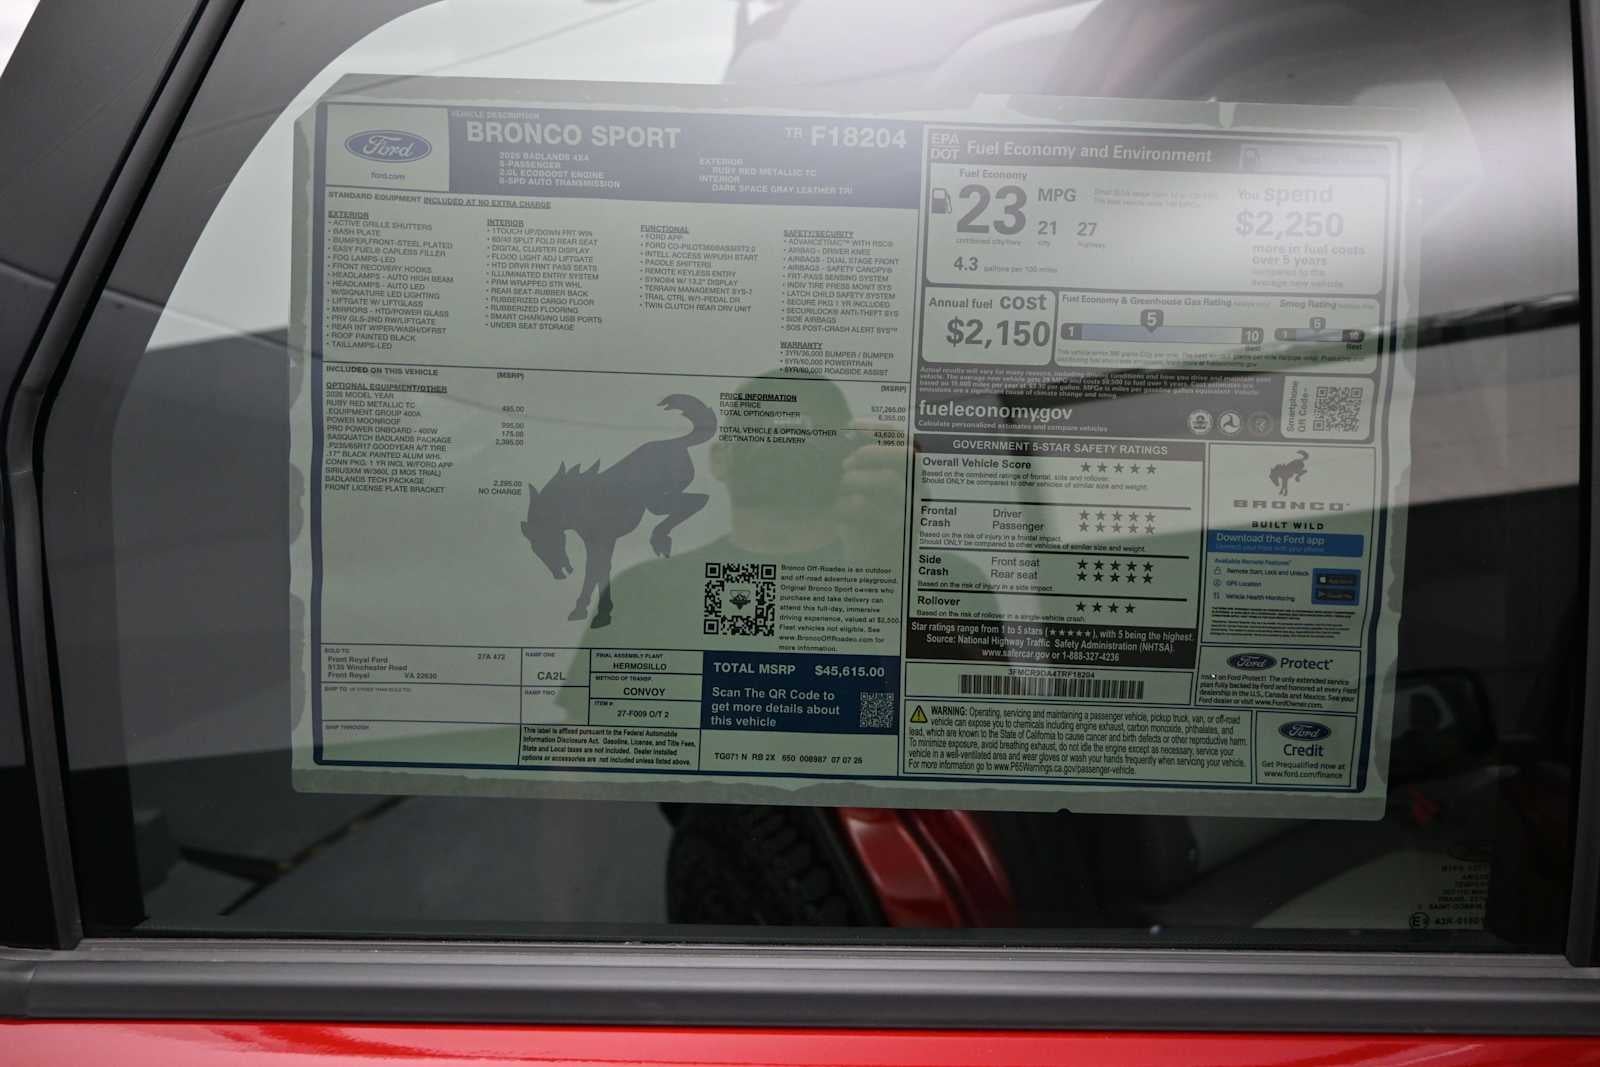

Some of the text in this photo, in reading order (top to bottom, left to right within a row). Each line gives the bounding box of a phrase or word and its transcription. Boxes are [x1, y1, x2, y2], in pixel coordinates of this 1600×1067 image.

[467, 121, 682, 149] BRONCO SPORT
[785, 125, 907, 149] TR F18204
[931, 134, 959, 144] EPA
[930, 148, 960, 160] DOT
[967, 141, 1212, 162] Fuel Economy and Environment
[370, 172, 406, 180] ford.com
[760, 168, 802, 176] METALLIC
[960, 168, 1028, 181] Fuel Economy
[554, 180, 621, 188] TRANSMISSION
[699, 175, 740, 184] INTERIOR
[712, 184, 768, 193] DARK SPACE
[328, 192, 551, 208] STANDARD EQUIPMENT EXTRA CHARGE
[1238, 188, 1333, 206] You spend
[328, 211, 369, 219] EXTERIOR
[956, 184, 1027, 235] 23
[1038, 188, 1077, 202] MPG
[392, 222, 432, 231] SHUTTERS
[488, 220, 524, 228] INTERIOR
[641, 225, 689, 233] FUNCTIONAL
[1038, 220, 1057, 236] 21
[1076, 222, 1098, 236] 27
[1235, 210, 1344, 240] $2,250
[1304, 245, 1328, 254] fuel
[1331, 246, 1365, 256] costs
[953, 256, 978, 272] 4.3
[1295, 257, 1327, 266] years
[928, 294, 1047, 310] Annual fuel cost
[1062, 295, 1080, 303] Fuel
[1081, 296, 1119, 306] Economy
[1130, 297, 1182, 306] Greenhouse
[1184, 298, 1201, 306] Gas
[1203, 298, 1232, 308] Rating
[1146, 312, 1157, 326] 5
[946, 316, 1050, 349] $2,150
[1068, 327, 1075, 337] 1
[1246, 331, 1259, 342] 10
[326, 383, 367, 391] OPTIONAL
[745, 393, 797, 402] INFORMATION
[919, 400, 1073, 422] fueleconomy.gov
[952, 440, 1168, 455] GOVERNMENT 5-STAR SAFETY RATINGS
[923, 457, 1032, 470] Overall Vehicle Score
[1233, 500, 1344, 511] BRONCO
[920, 506, 1022, 519] Frontal Driver
[920, 518, 1044, 532] Crash Passenger
[1252, 521, 1287, 529] BUILT
[1216, 533, 1325, 546] Download the Ford app
[919, 555, 1040, 568] Side Front seat
[918, 566, 1038, 580] Crash Rear seat
[918, 596, 960, 606] Rollover
[911, 622, 928, 632] Star
[929, 624, 956, 634] ratings
[957, 626, 979, 635] range
[981, 624, 999, 634] from
[1007, 626, 1014, 635] to
[1016, 626, 1022, 635] 5
[1023, 627, 1043, 636] stars
[1100, 630, 1116, 639] with
[1124, 631, 1147, 641] being
[1148, 631, 1160, 640] the
[926, 634, 1138, 651] Source: National Highway Traffic Safety Administration
[982, 649, 1050, 660] www.safercar.gov
[1062, 651, 1119, 661] 1-888-327-4236
[713, 662, 885, 678] TOTAL MSRP $45,615.00
[1280, 658, 1329, 670] Protect
[537, 672, 566, 681] CA2L
[623, 688, 666, 696] CONVOY
[712, 687, 835, 701] Scan The QR Code to
[711, 703, 840, 715] get more details about
[930, 706, 967, 716] WARNING:
[711, 715, 777, 727] this vehicle
[1284, 744, 1324, 757] Credit
[940, 762, 974, 770] information
[976, 764, 985, 772] go
[1276, 762, 1319, 770] Prequalified
